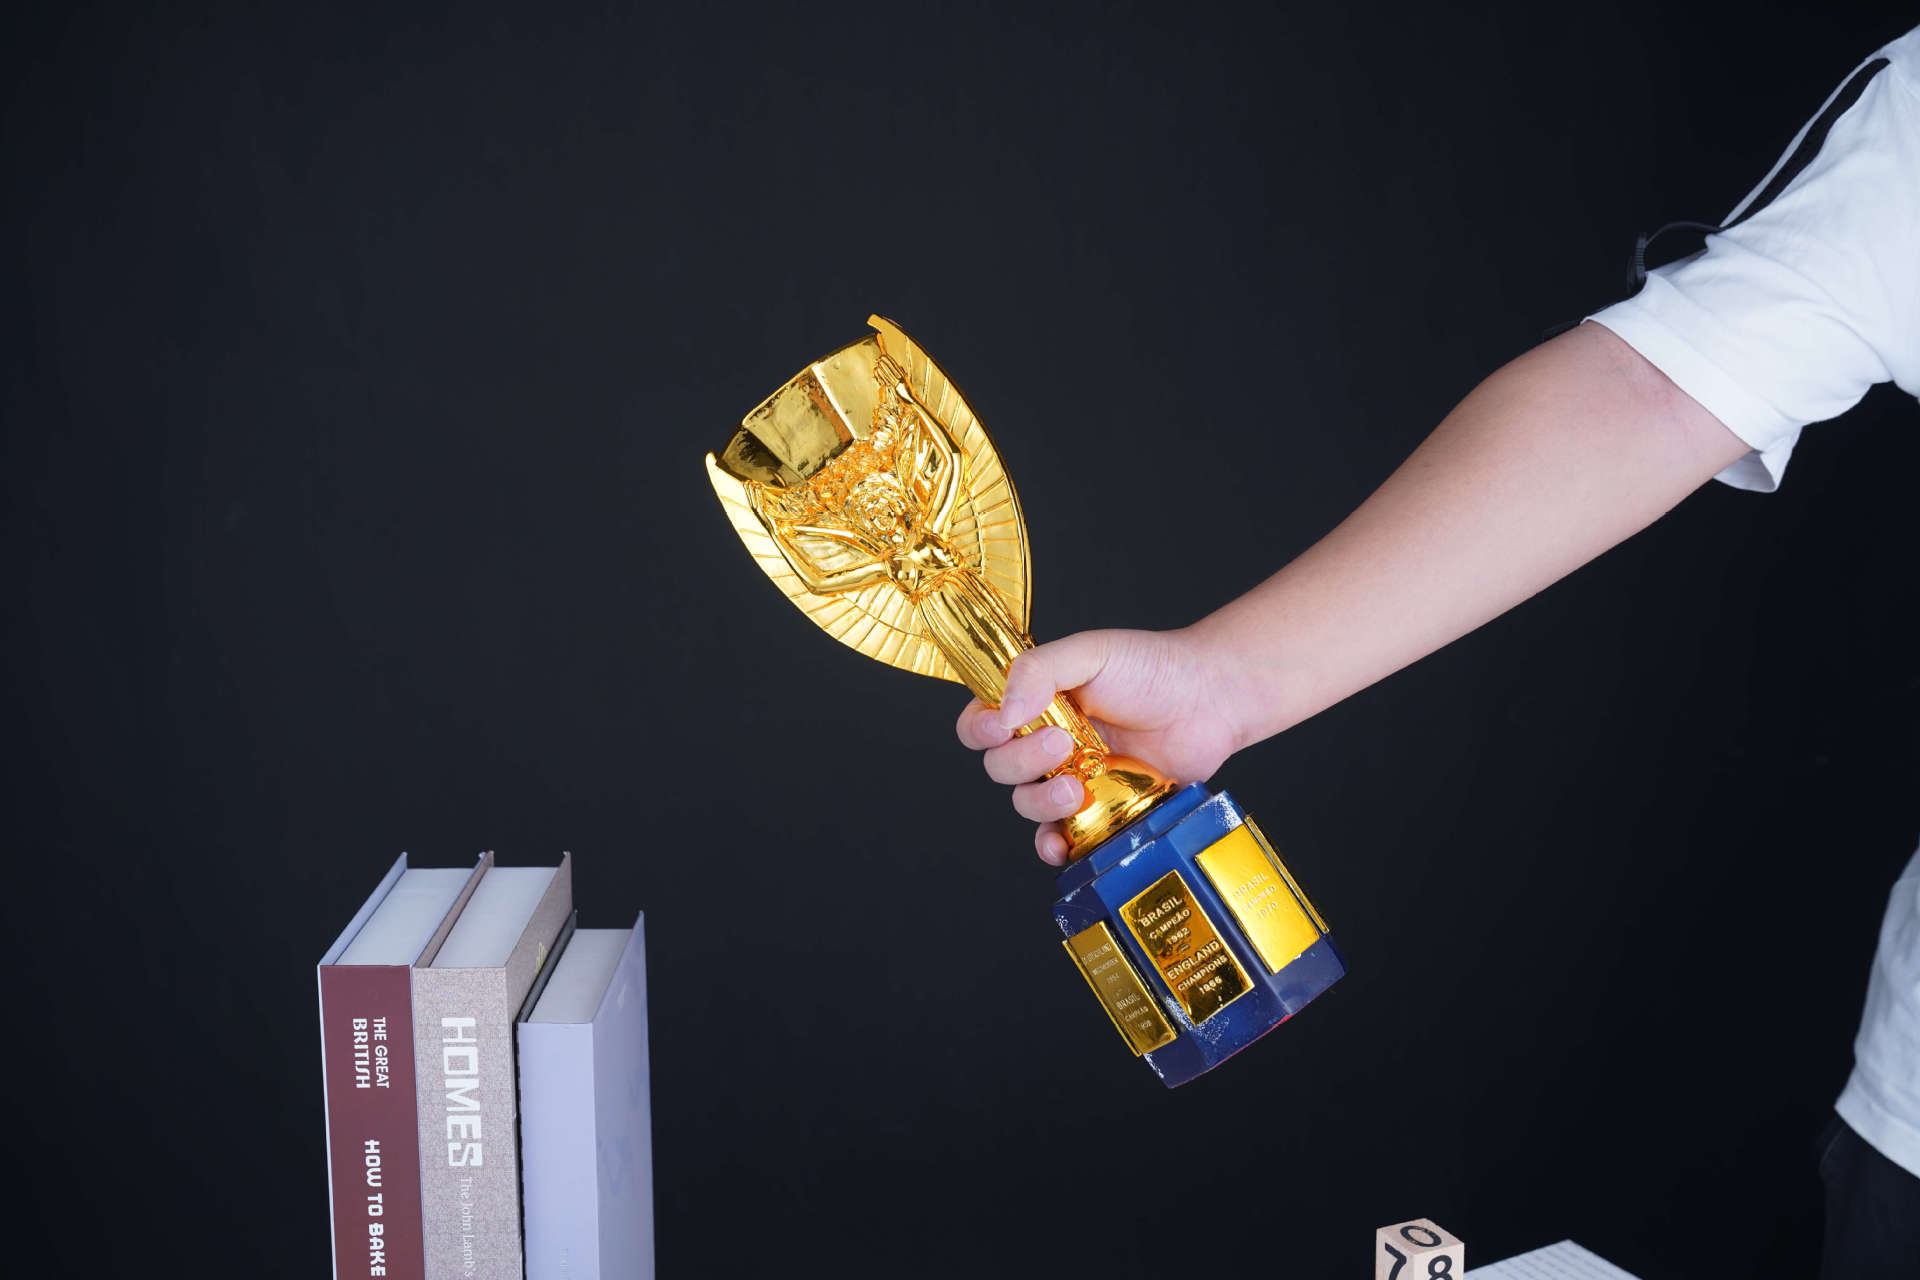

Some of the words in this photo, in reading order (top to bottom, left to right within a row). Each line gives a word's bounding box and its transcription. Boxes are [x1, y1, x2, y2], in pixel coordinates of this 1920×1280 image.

[1140, 896, 1183, 927] BRASIL
[1167, 927, 1190, 945] 1962
[1167, 940, 1220, 980] ENGLAND
[1177, 955, 1228, 992] CHAMPIONS
[1199, 976, 1222, 995] 1966
[373, 1016, 387, 1041] THE
[352, 1018, 371, 1089] BRITISH
[374, 1045, 390, 1089] GREAT
[441, 1017, 483, 1167] HOMES
[364, 1139, 382, 1187] HOW
[460, 1176, 473, 1199] The
[367, 1193, 383, 1217] TO
[460, 1200, 474, 1231] John
[368, 1223, 386, 1277] BAKE
